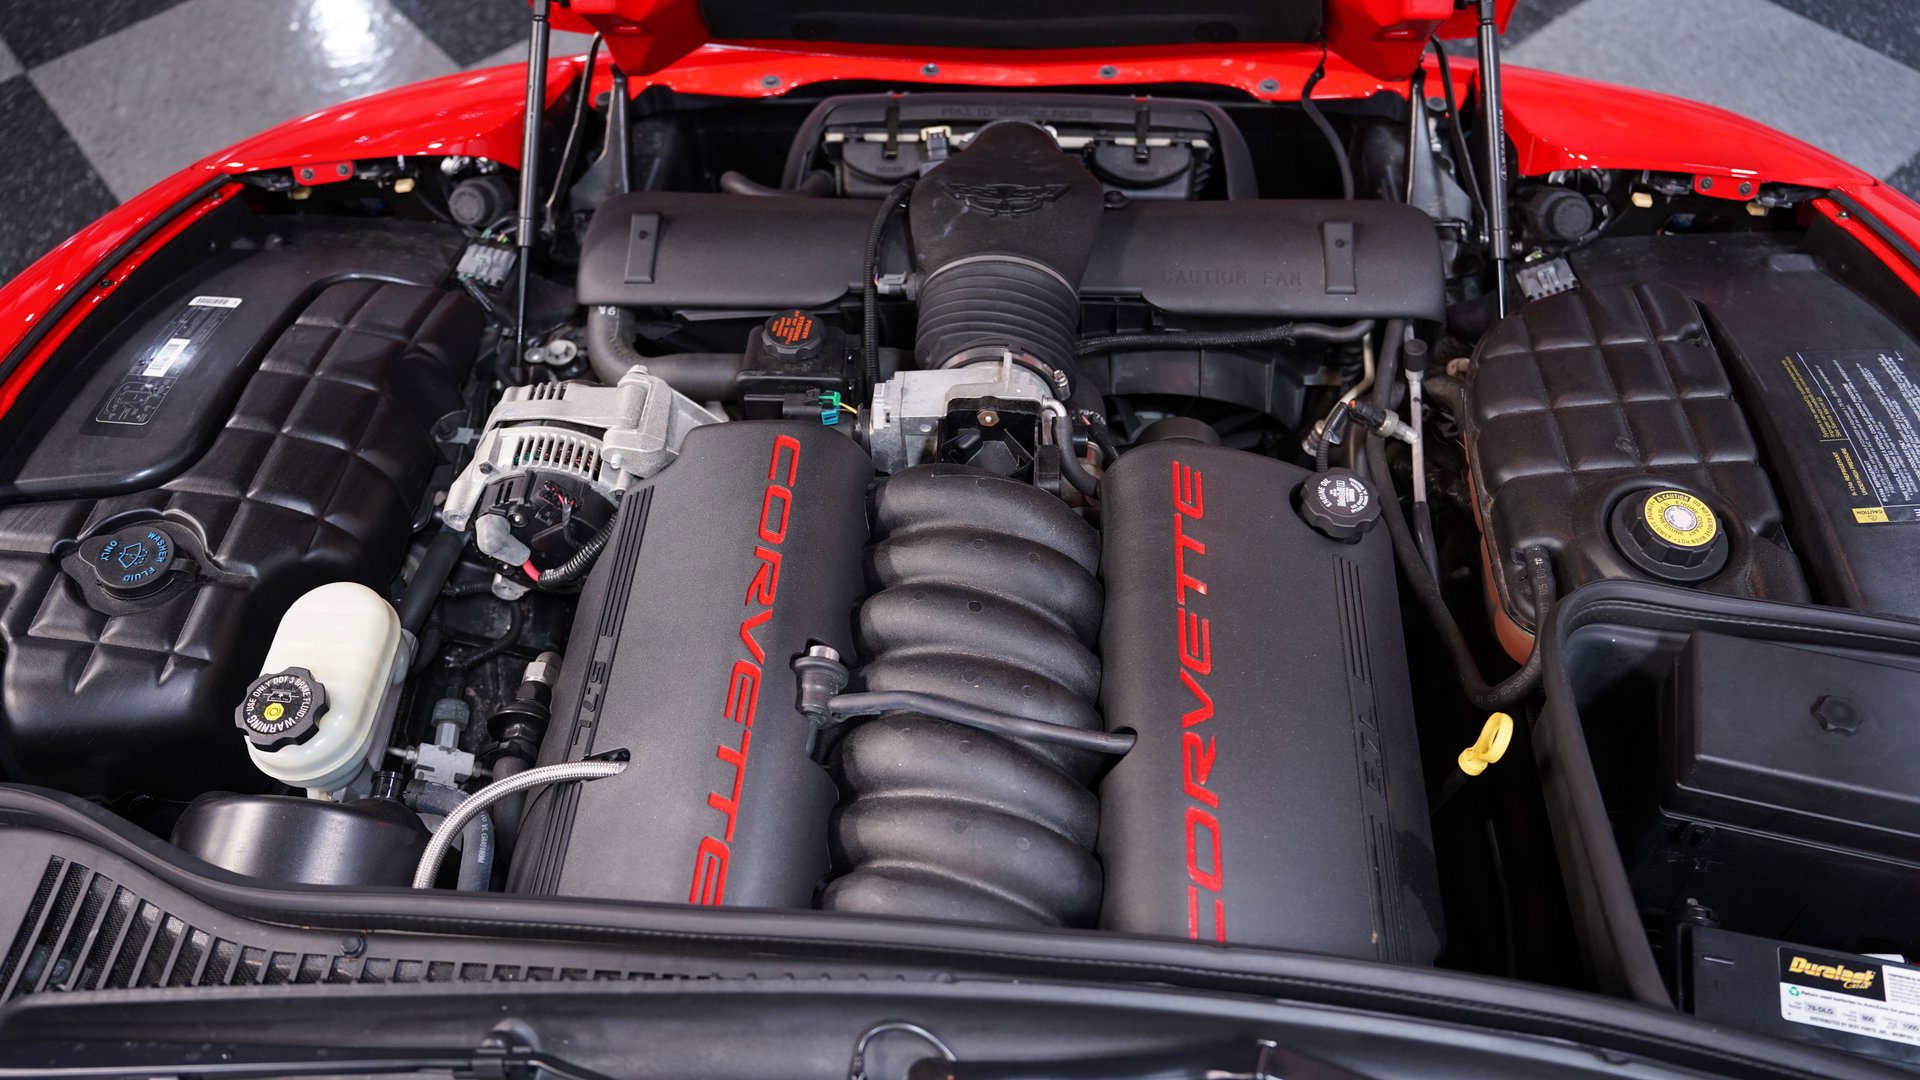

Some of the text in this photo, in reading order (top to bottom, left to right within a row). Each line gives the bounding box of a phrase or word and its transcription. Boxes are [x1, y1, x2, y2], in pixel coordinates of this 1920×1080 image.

[1161, 269, 1302, 286] CAUTION FAN
[1318, 478, 1332, 507] ENGINE OIL
[1662, 494, 1688, 502] CAUTION
[101, 540, 118, 561] ONLY
[148, 532, 168, 563] WASHER
[122, 566, 156, 582] FLUID
[690, 434, 800, 905] CORVETTE
[253, 681, 271, 698] ONLY
[273, 676, 290, 684] DOT
[294, 678, 311, 697] BRAKE
[246, 698, 256, 712] USE
[296, 698, 312, 718] FLUID
[573, 660, 606, 746] 5.7L
[1172, 461, 1226, 943] CORVETTE
[246, 714, 296, 733] WARNING
[1788, 956, 1876, 983] Duralast
